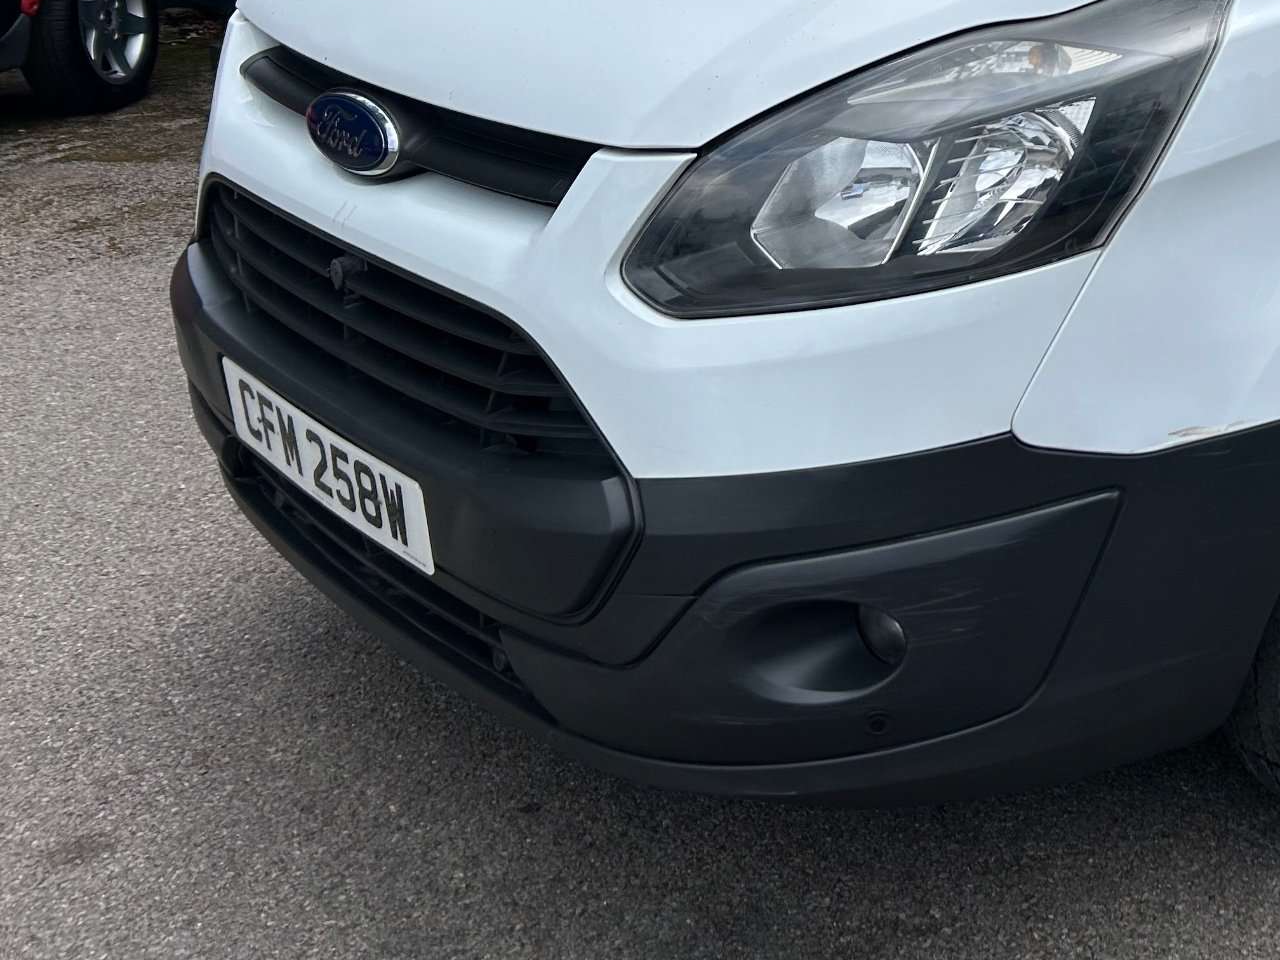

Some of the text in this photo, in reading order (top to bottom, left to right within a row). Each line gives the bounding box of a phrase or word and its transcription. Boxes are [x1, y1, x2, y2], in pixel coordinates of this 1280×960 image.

[317, 104, 367, 158] Ford
[239, 377, 408, 547] CFM 258W
